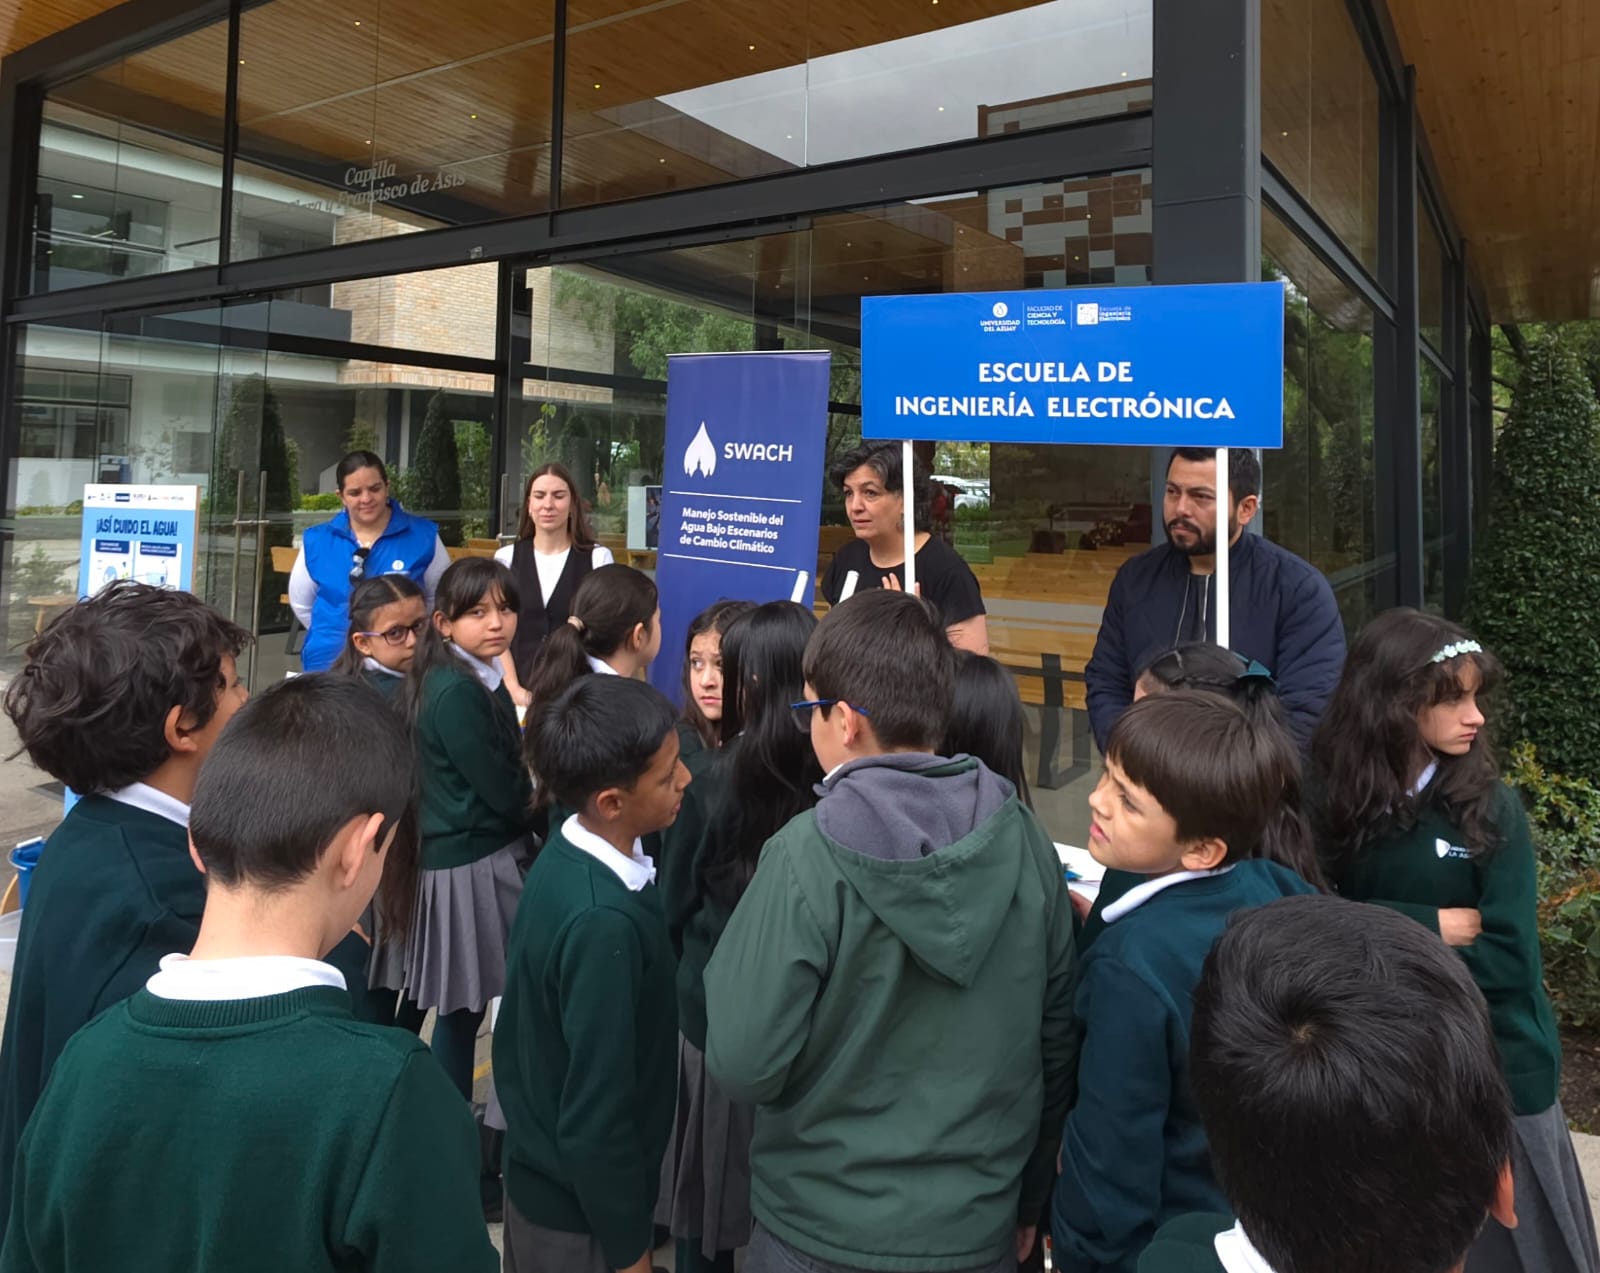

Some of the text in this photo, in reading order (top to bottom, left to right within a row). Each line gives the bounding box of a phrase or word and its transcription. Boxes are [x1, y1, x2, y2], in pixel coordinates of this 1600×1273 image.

[344, 159, 397, 187] Capilla
[336, 183, 407, 207] Francisco
[409, 174, 429, 195] de
[979, 361, 1133, 383] ESCUELA DE
[894, 391, 1236, 420] INGENIERÍA ELECTRÓNICA
[723, 442, 793, 462] SWACH
[682, 507, 784, 526] Manejo Sostenible del
[113, 518, 139, 535] CUIDO
[139, 520, 151, 535] EL
[152, 520, 178, 537] AGUA!
[680, 521, 778, 540] Agua Bajo Escenarios
[679, 535, 775, 554] de Cambio Climático
